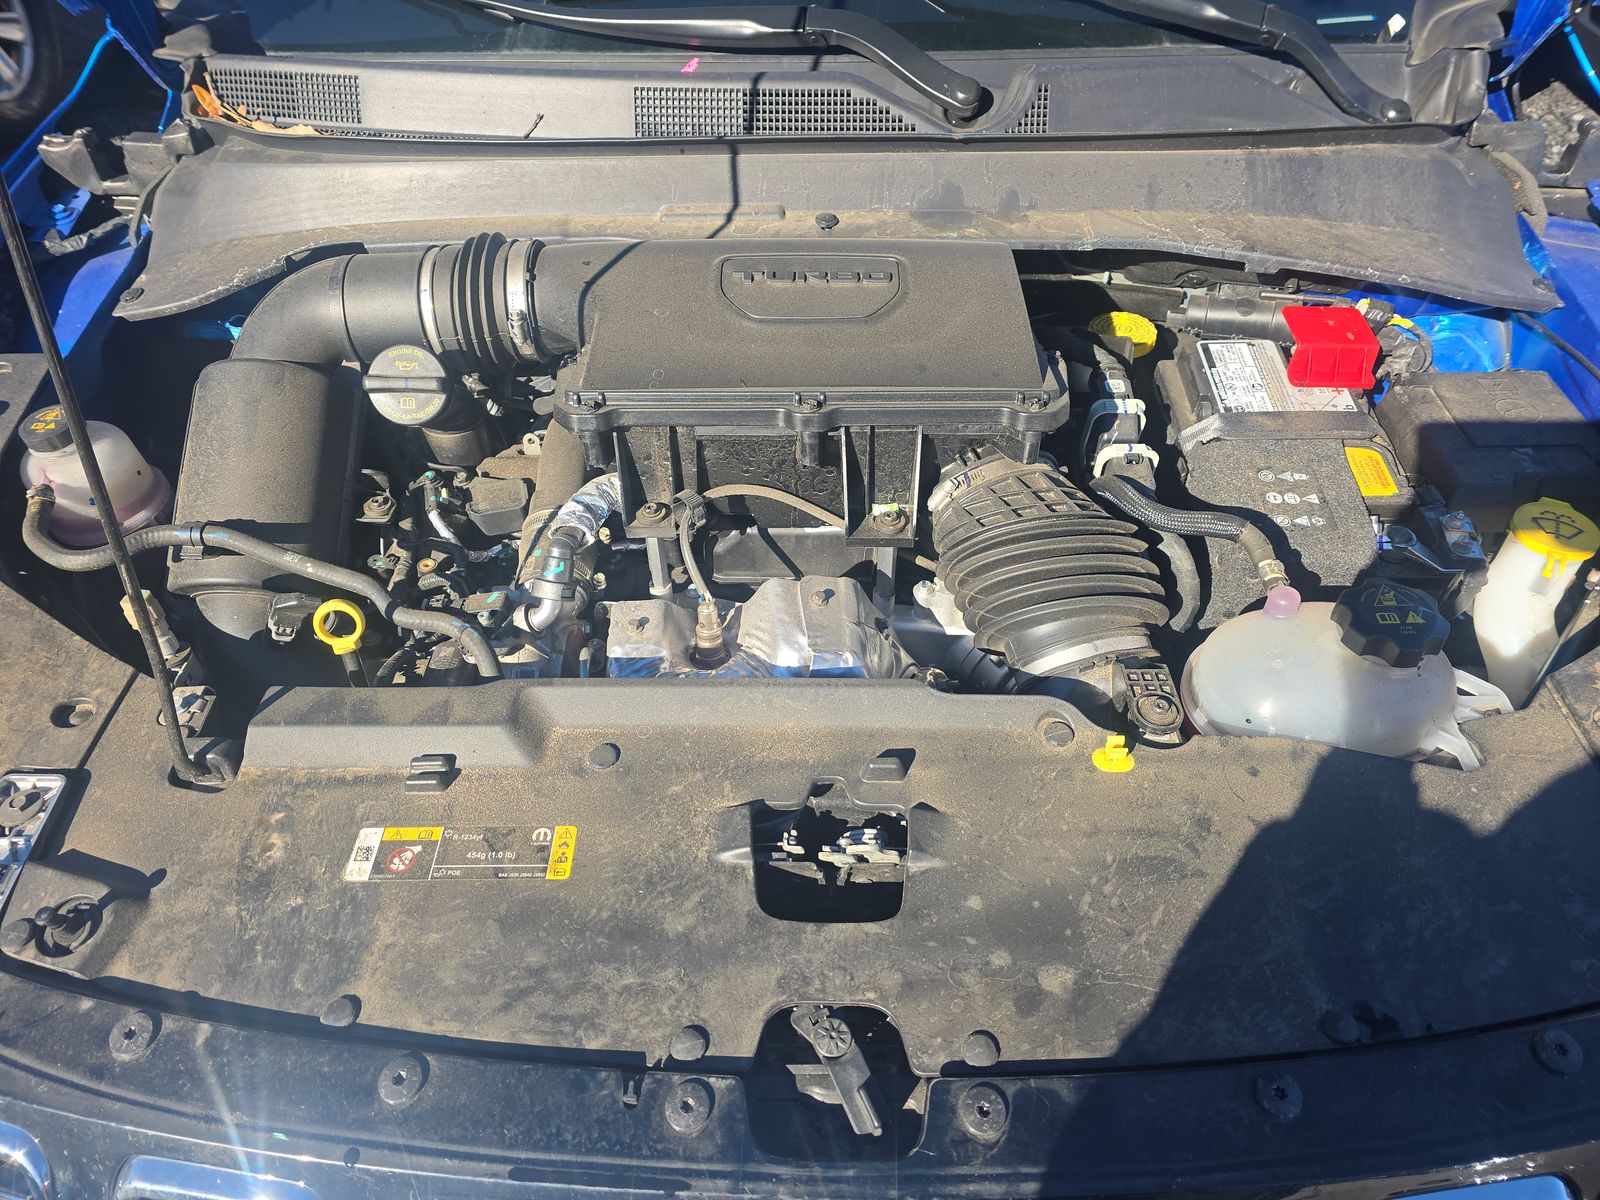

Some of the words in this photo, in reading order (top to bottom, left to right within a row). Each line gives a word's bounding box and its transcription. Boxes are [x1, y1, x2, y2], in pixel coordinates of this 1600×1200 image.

[732, 270, 893, 285] TURBO
[388, 348, 413, 357] ENGINE
[413, 350, 424, 358] OIL
[452, 833, 484, 841] R-1234yf
[466, 851, 486, 860] 454g
[487, 851, 503, 860] (1.0
[504, 851, 516, 860] lb)
